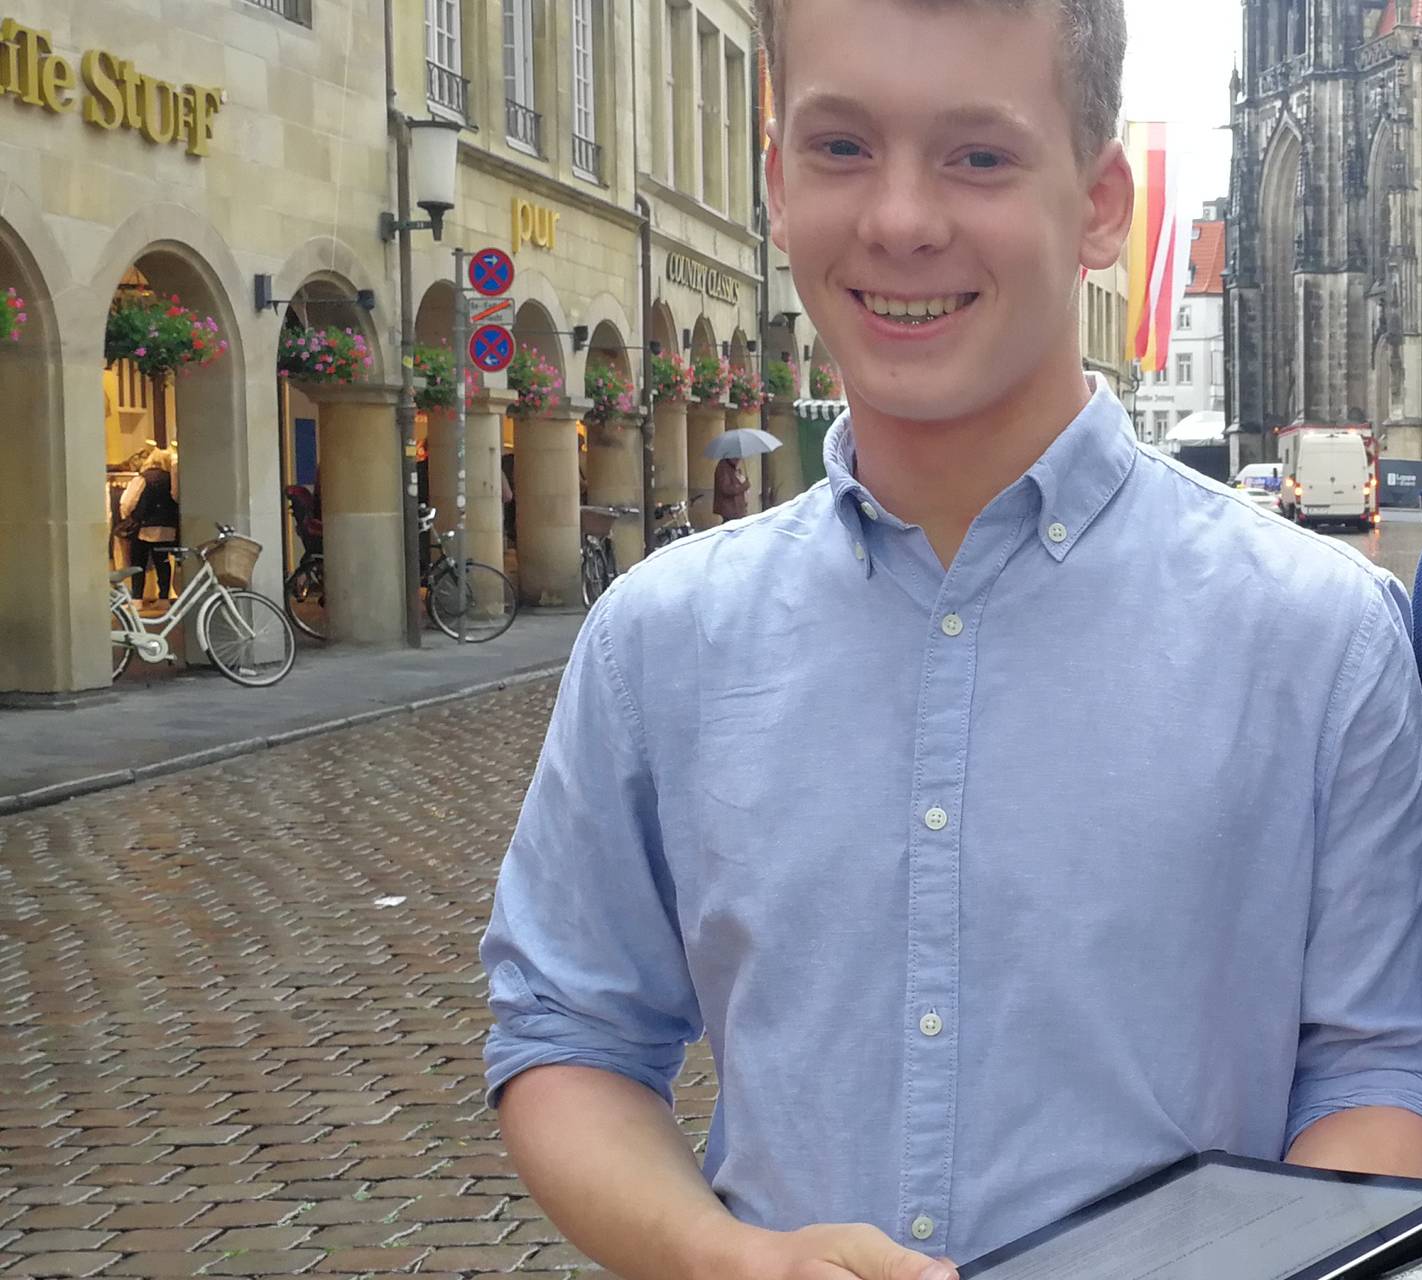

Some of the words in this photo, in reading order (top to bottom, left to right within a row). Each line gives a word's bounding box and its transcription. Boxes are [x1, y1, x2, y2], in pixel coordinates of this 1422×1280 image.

[511, 197, 560, 254] pur
[667, 252, 708, 295] COUNTRY
[706, 268, 740, 306] CLASSICS
